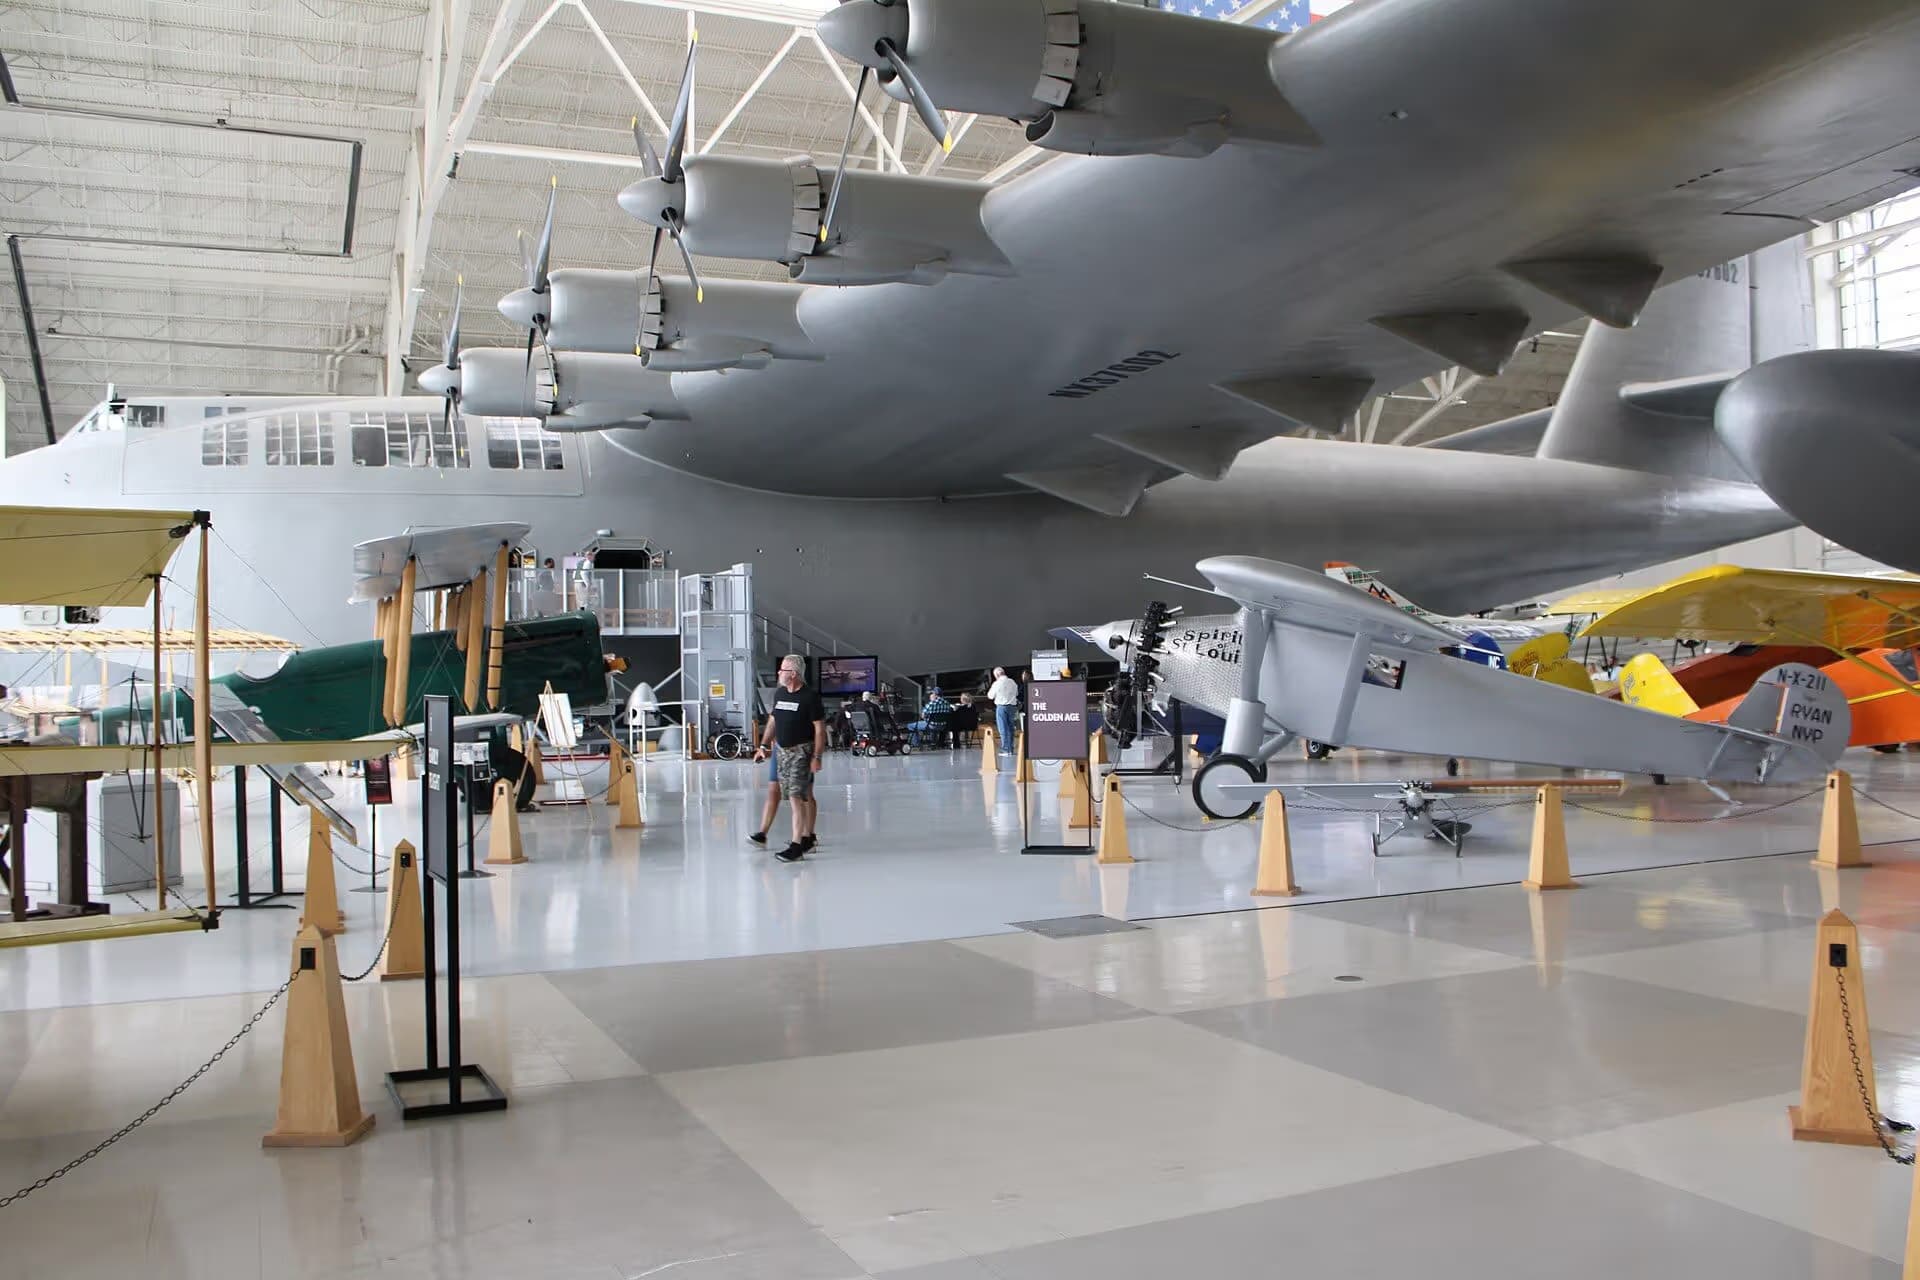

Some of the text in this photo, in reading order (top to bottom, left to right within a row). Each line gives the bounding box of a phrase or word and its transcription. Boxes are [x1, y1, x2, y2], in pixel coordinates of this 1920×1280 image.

[1195, 643, 1240, 664] Loui
[1777, 668, 1827, 691] N-X-211
[1032, 702, 1047, 711] THE
[1791, 703, 1833, 725] RYAN
[1032, 713, 1081, 722] GOLDEN AGE
[1791, 725, 1824, 744] NYP
